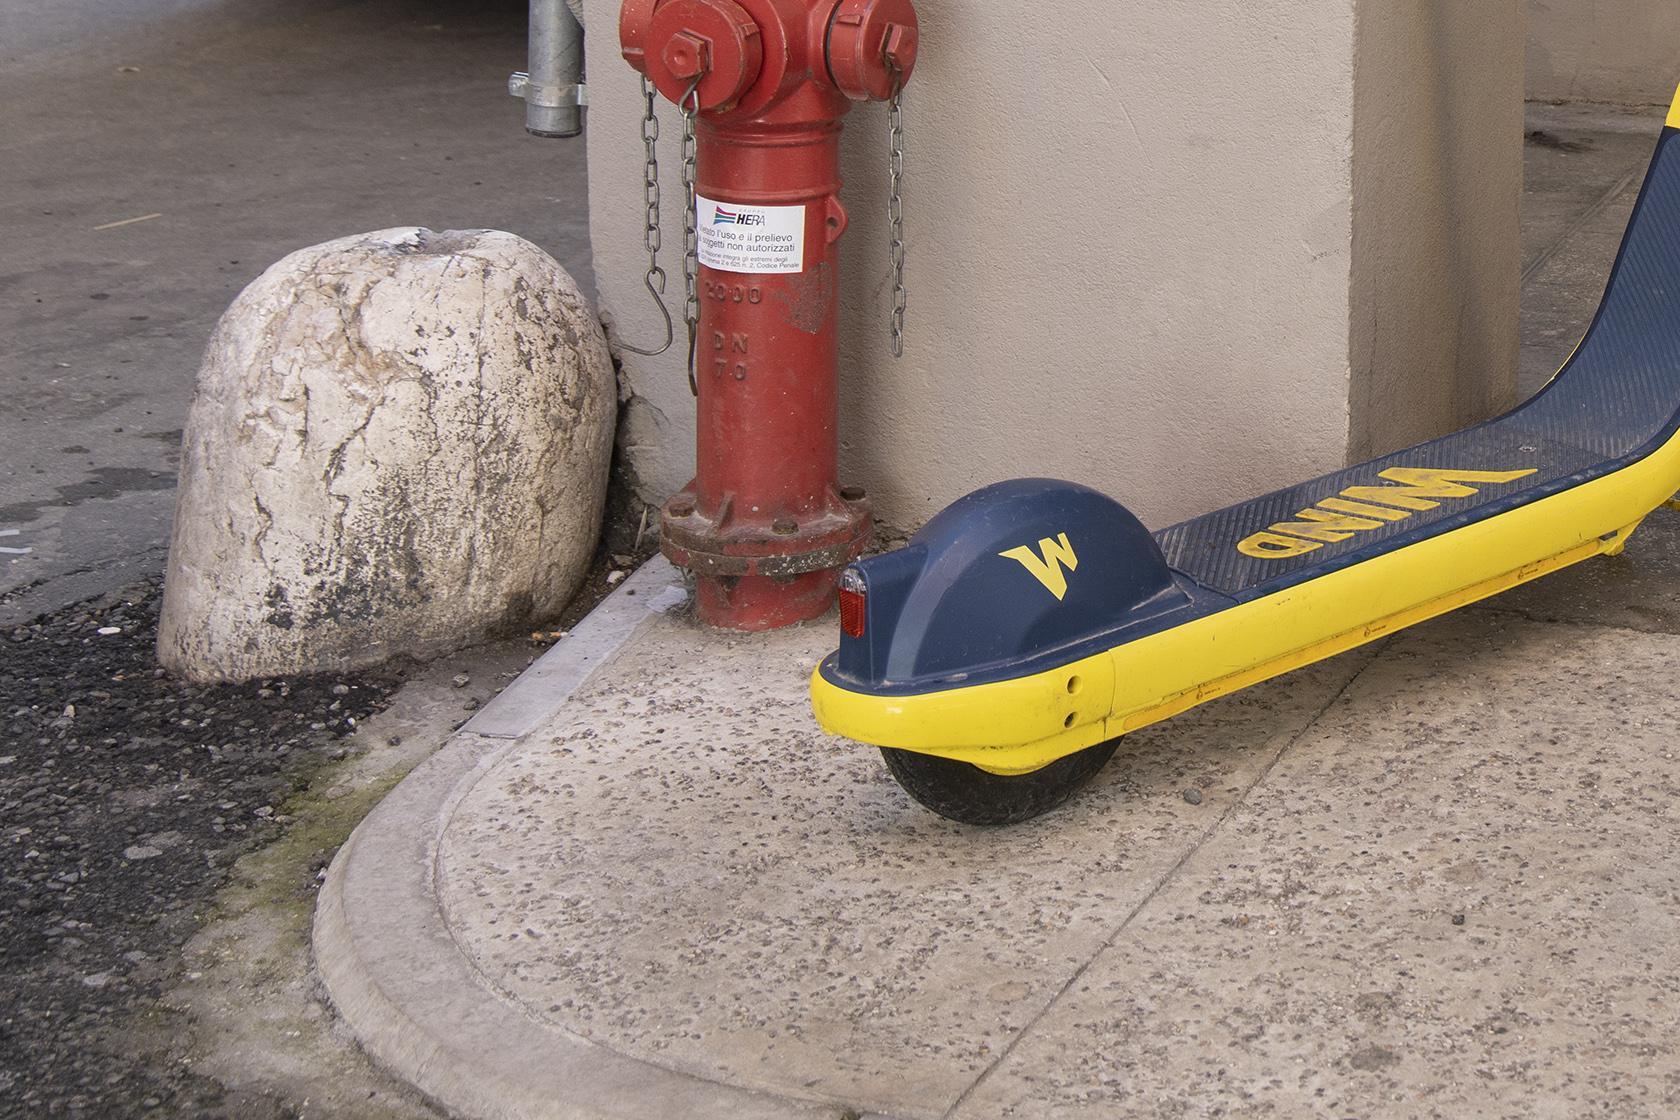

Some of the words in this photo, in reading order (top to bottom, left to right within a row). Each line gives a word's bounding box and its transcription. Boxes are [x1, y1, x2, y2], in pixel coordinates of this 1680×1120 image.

[736, 213, 766, 226] HERA
[716, 228, 736, 240] l'uso
[747, 232, 752, 240] il
[754, 233, 792, 242] prelievo
[727, 243, 743, 251] non
[746, 244, 794, 252] autorizzati
[1237, 467, 1538, 559] WIND
[998, 532, 1078, 601] W
